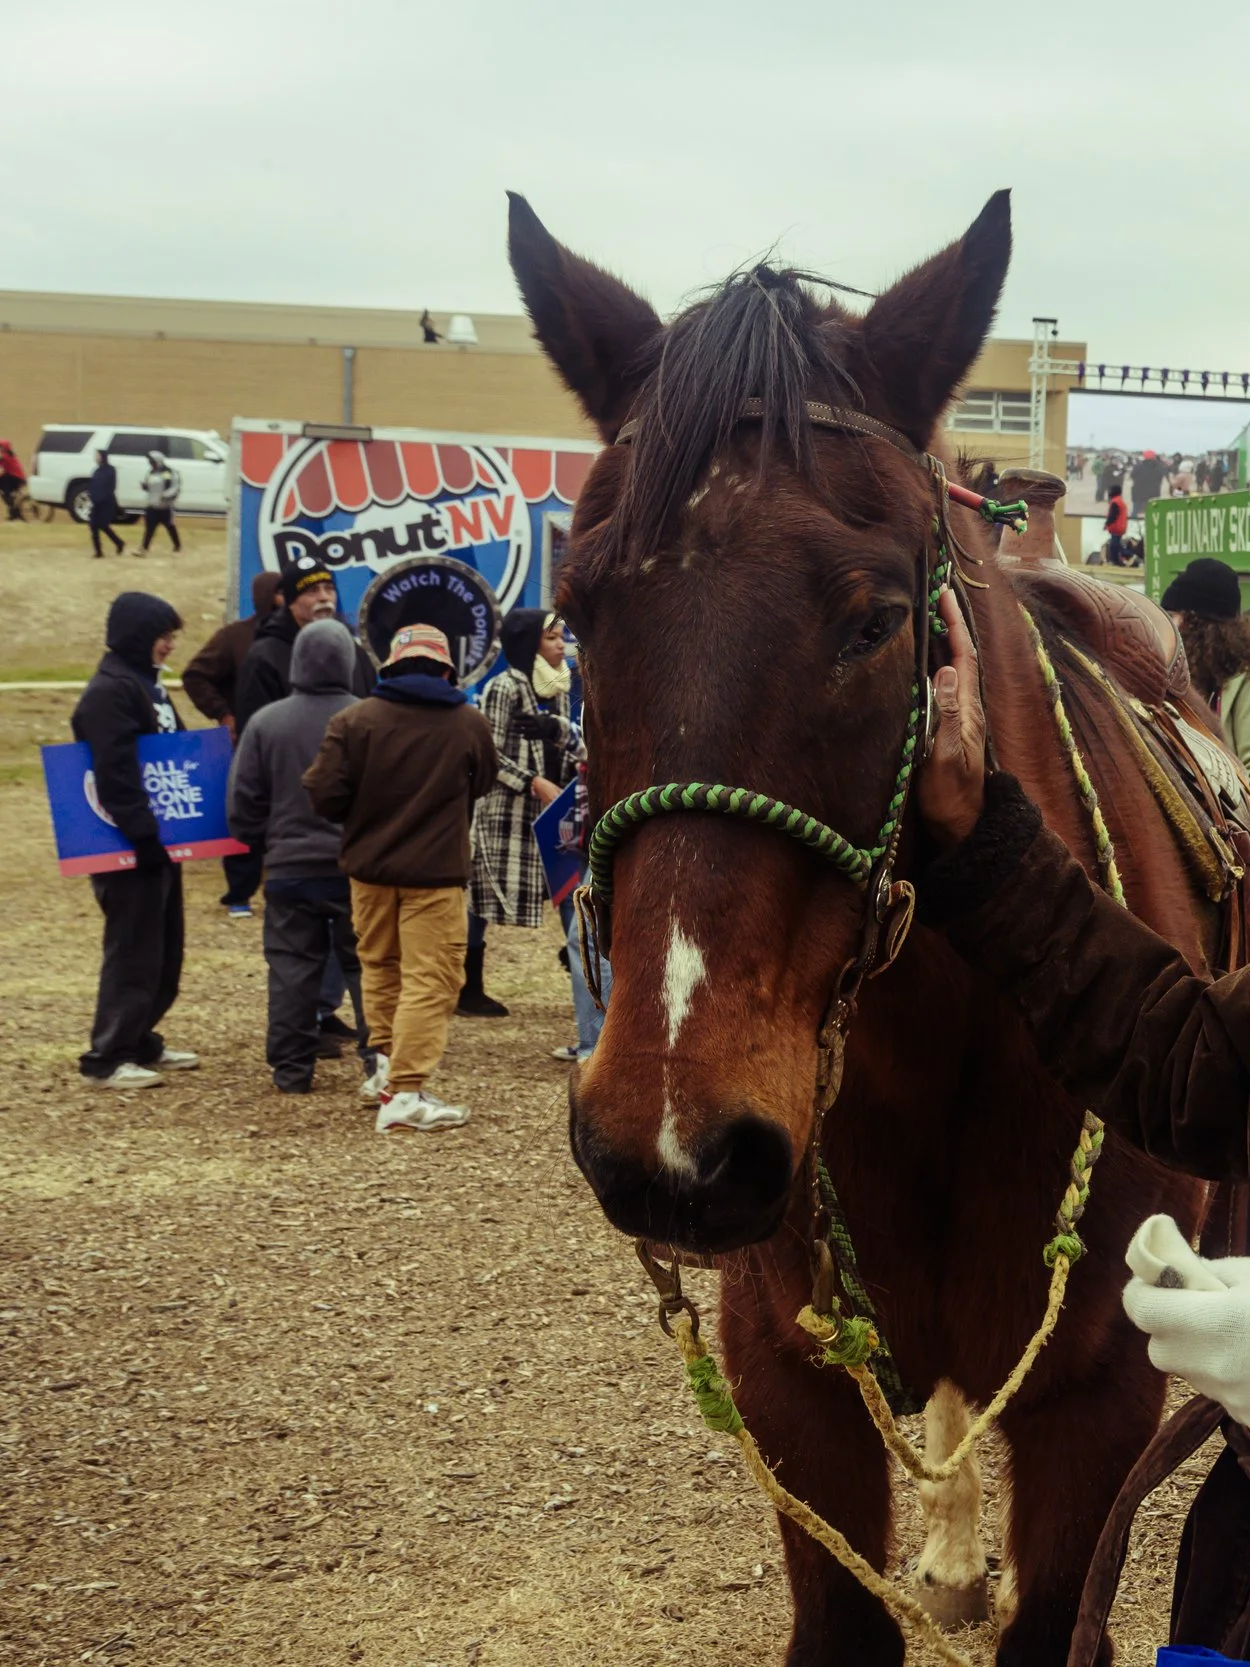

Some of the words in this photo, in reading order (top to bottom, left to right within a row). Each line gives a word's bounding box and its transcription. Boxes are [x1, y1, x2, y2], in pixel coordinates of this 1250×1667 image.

[1165, 507, 1226, 555] CULINARY
[383, 569, 441, 603] Watch
[447, 574, 474, 603] The
[465, 603, 488, 669] Donuts
[143, 760, 182, 778] ALL
[144, 773, 190, 793] ONE
[157, 786, 203, 806] ONE
[164, 803, 204, 820] ALL
